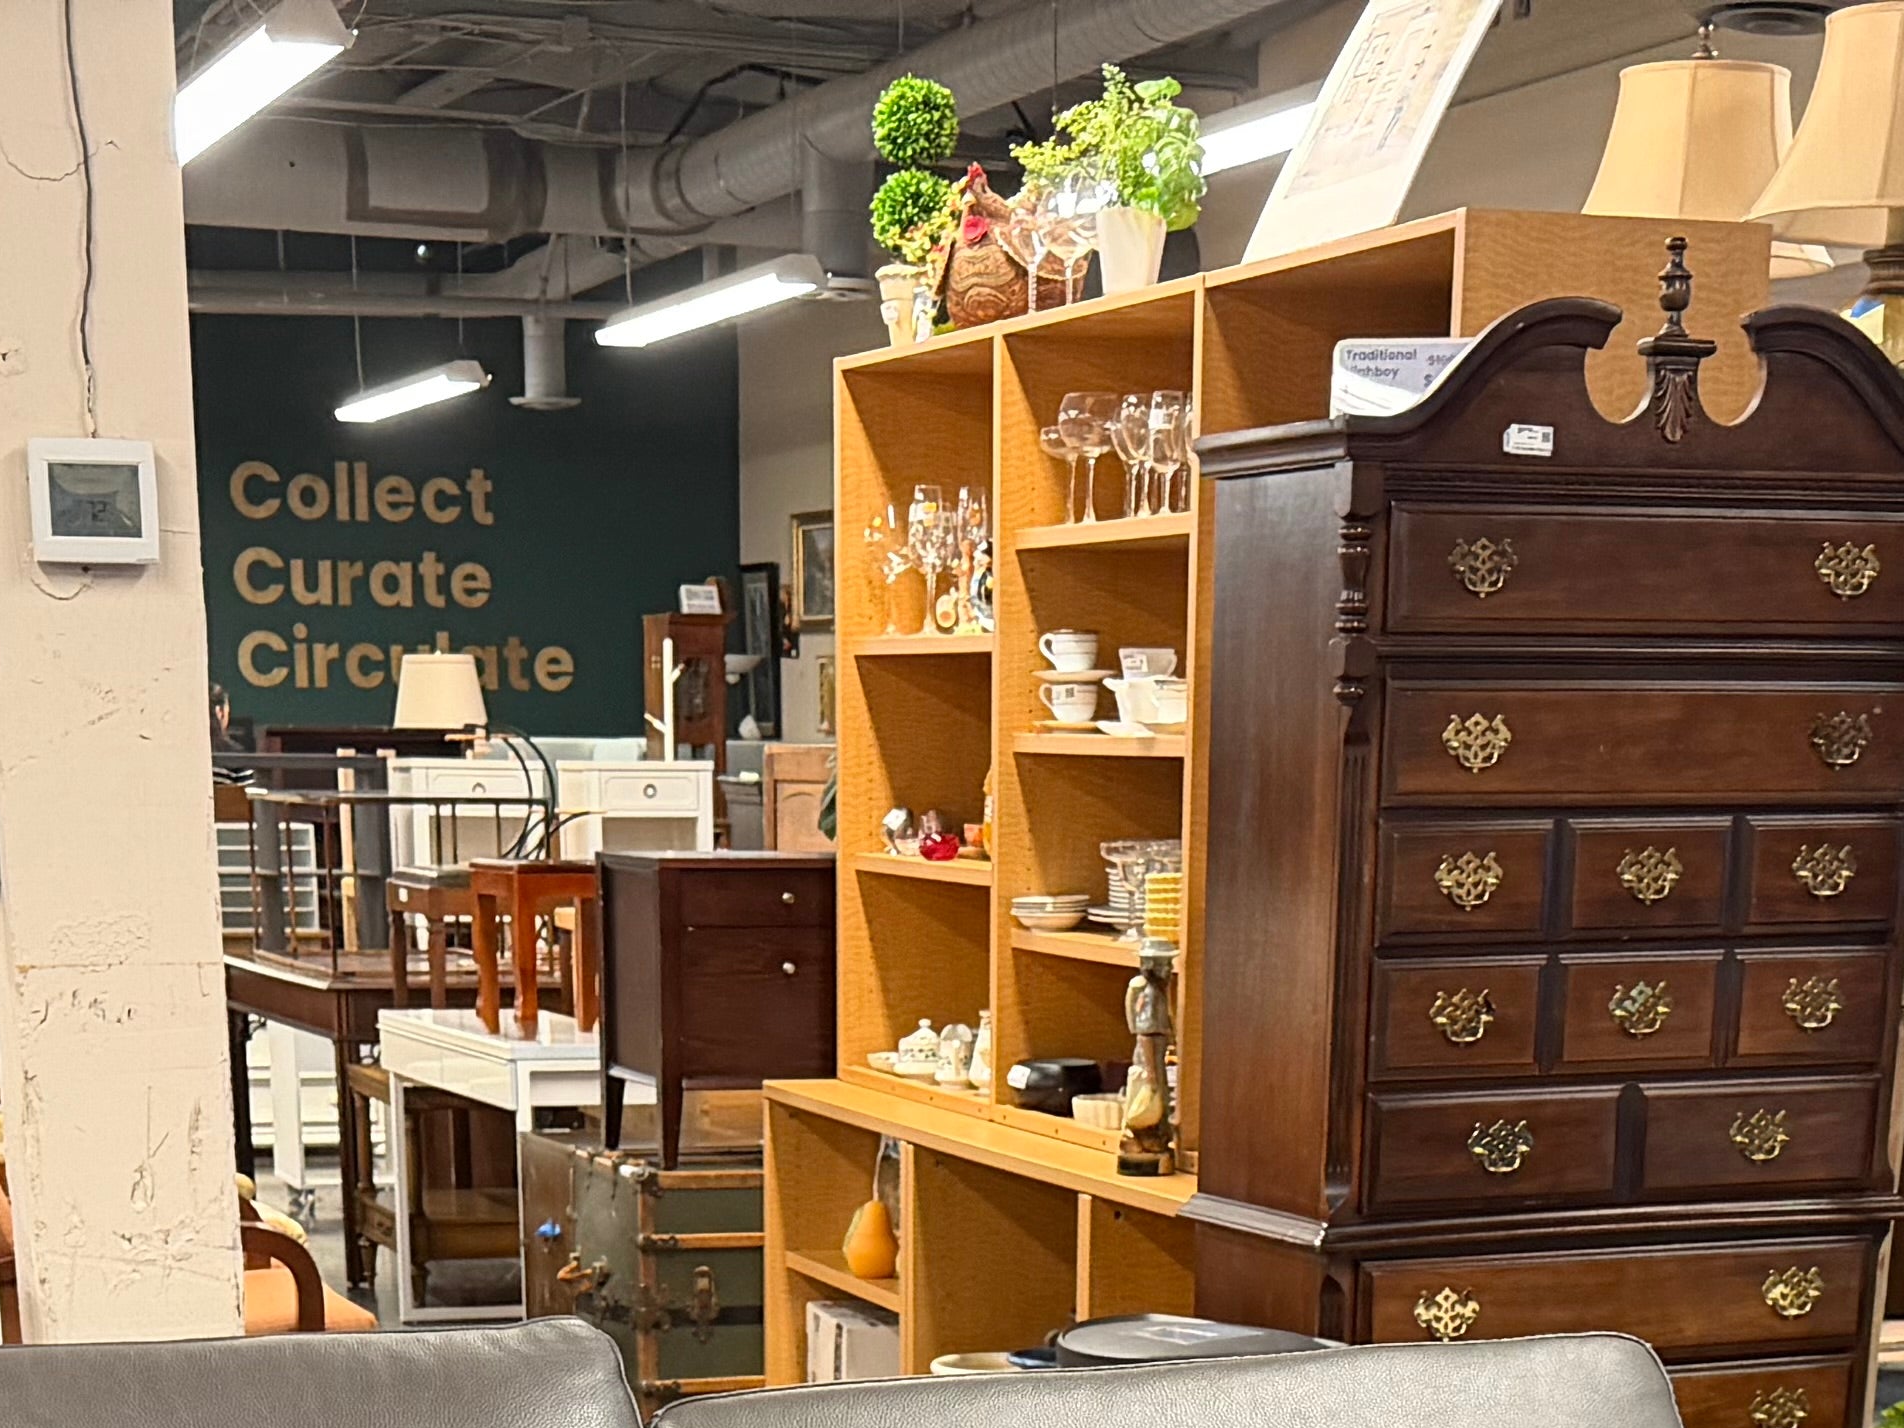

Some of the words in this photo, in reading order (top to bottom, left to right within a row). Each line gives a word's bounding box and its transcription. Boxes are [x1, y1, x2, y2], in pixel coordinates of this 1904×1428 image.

[1346, 349, 1417, 361] Traditional
[229, 460, 495, 525] Collect
[233, 546, 493, 608] Curate
